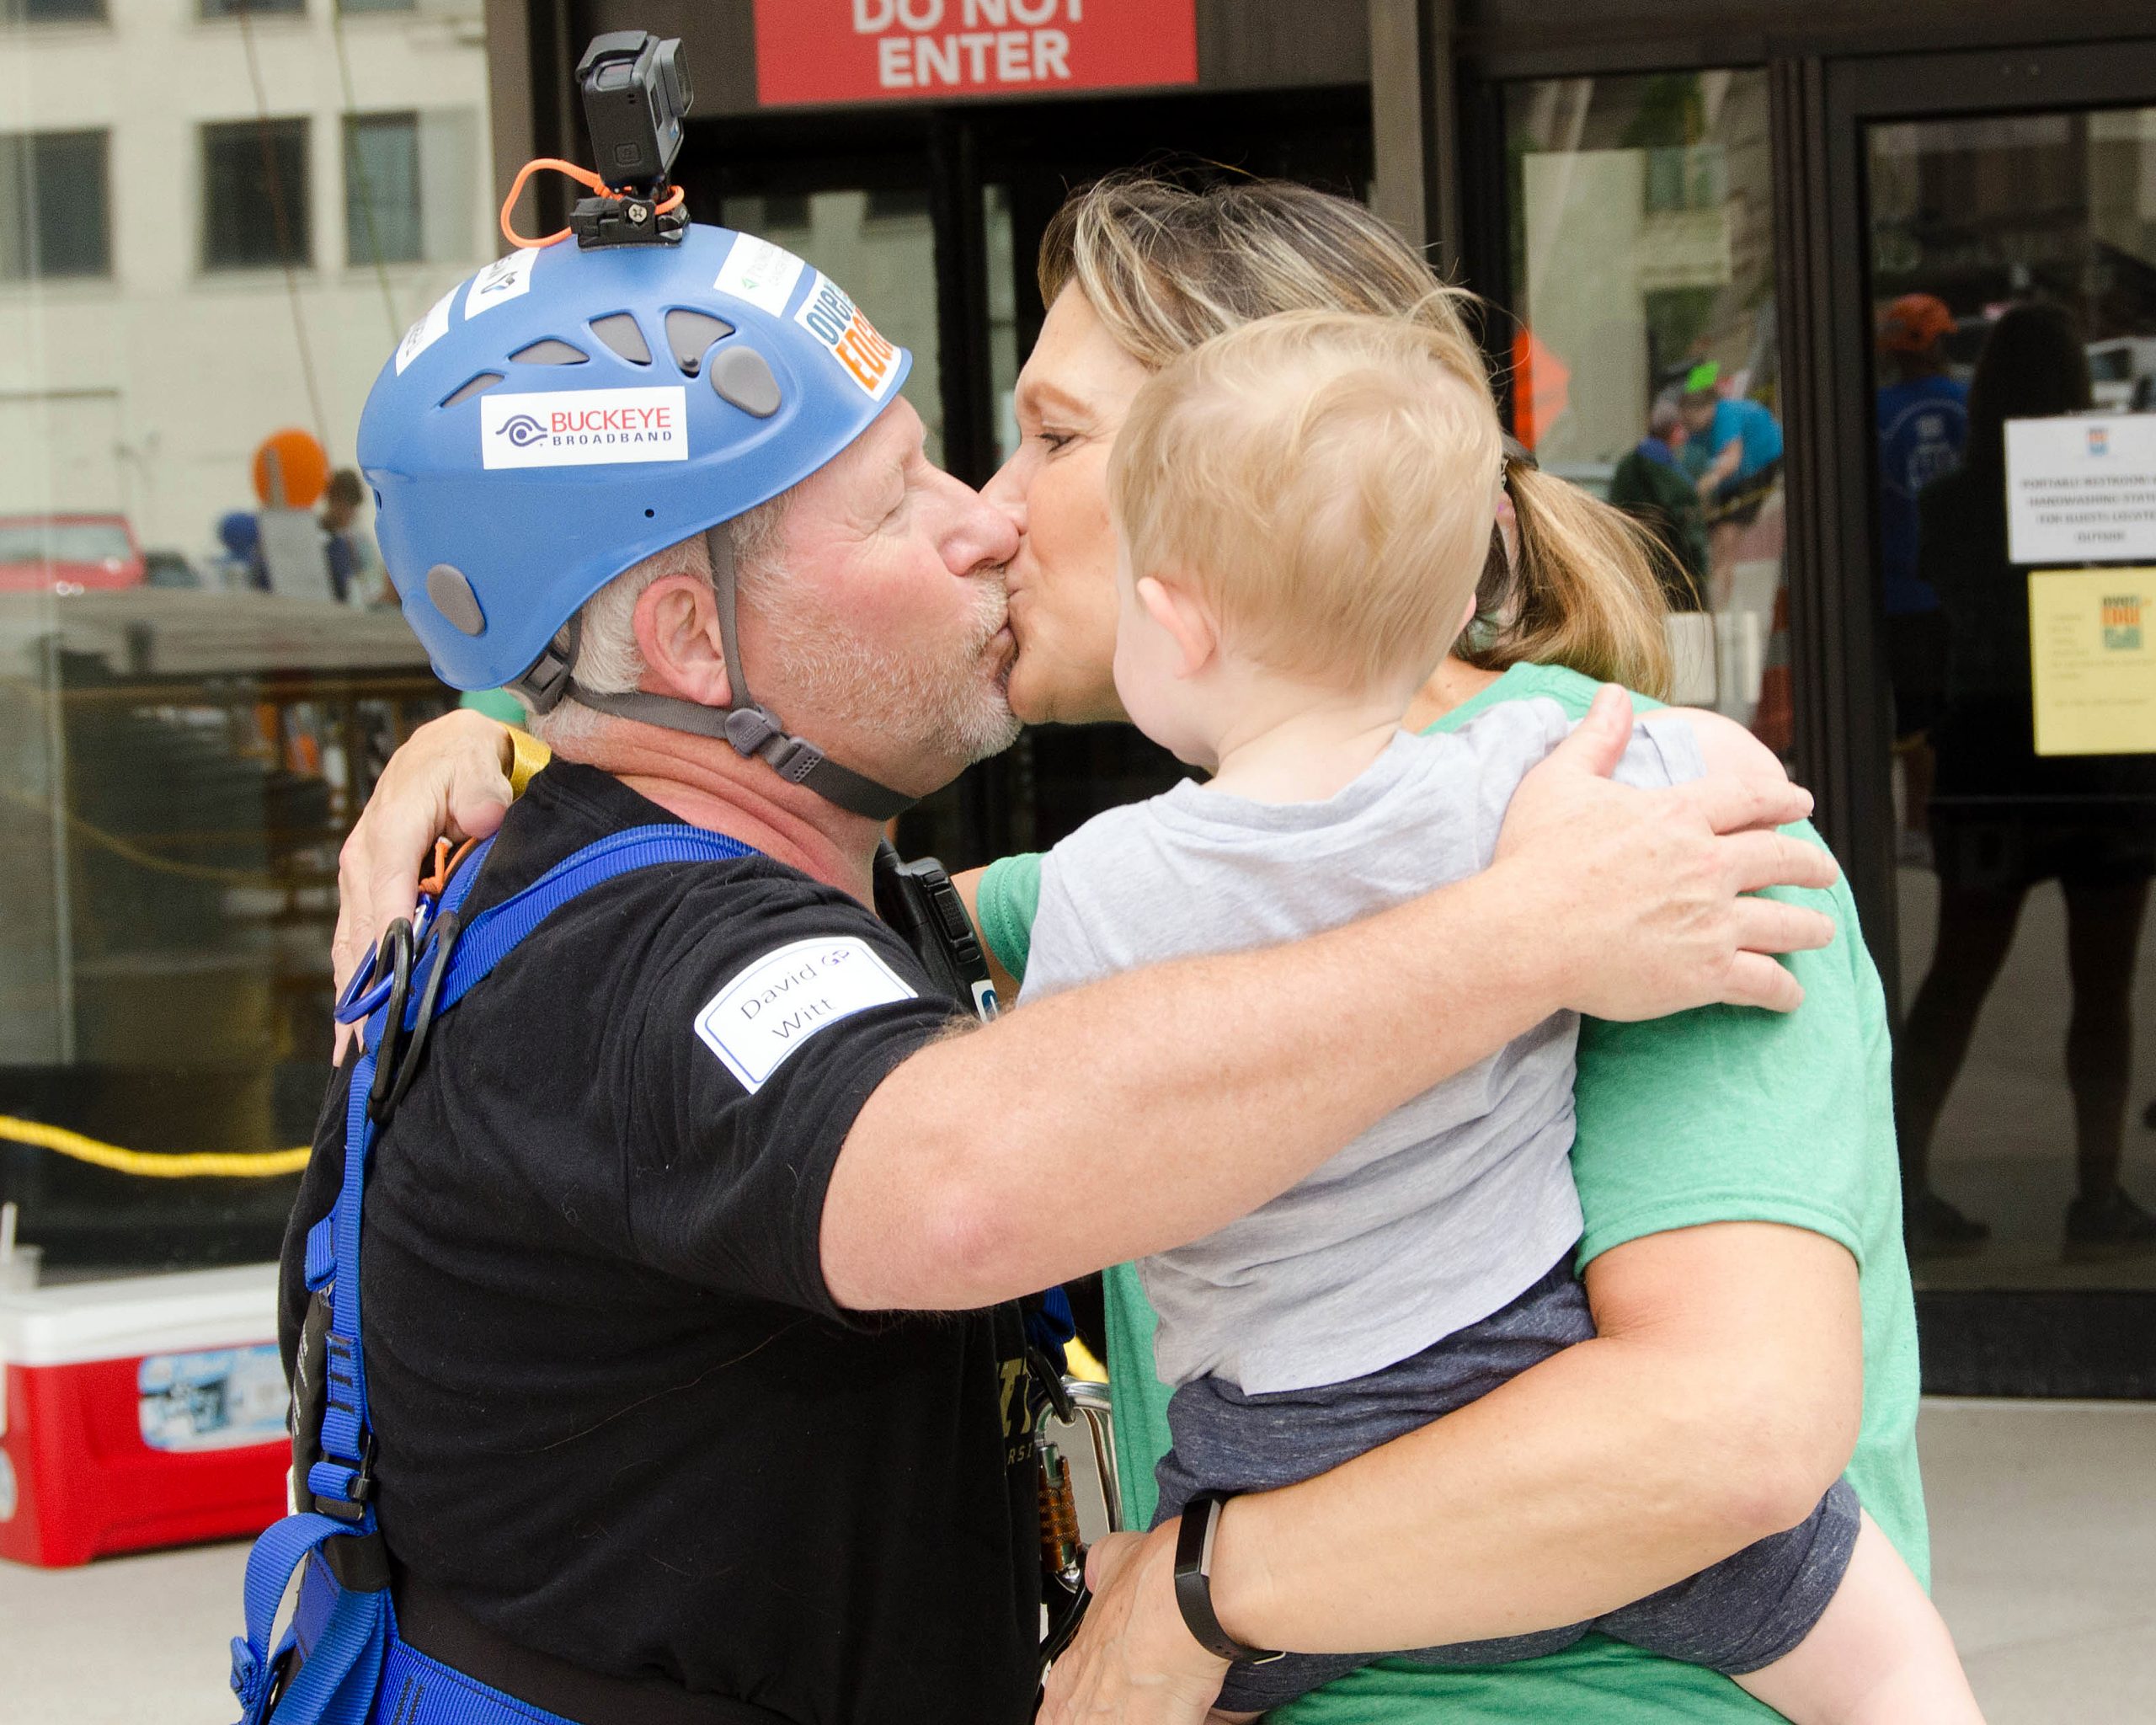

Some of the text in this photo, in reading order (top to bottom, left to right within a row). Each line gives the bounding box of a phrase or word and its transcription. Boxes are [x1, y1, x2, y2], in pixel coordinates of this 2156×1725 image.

[852, 0, 944, 34] DO
[878, 29, 1071, 88] ENTER
[551, 407, 671, 433] BUCKEYE
[552, 430, 673, 446] BROADBAND
[740, 963, 818, 1020] David
[771, 998, 838, 1039] Witt
